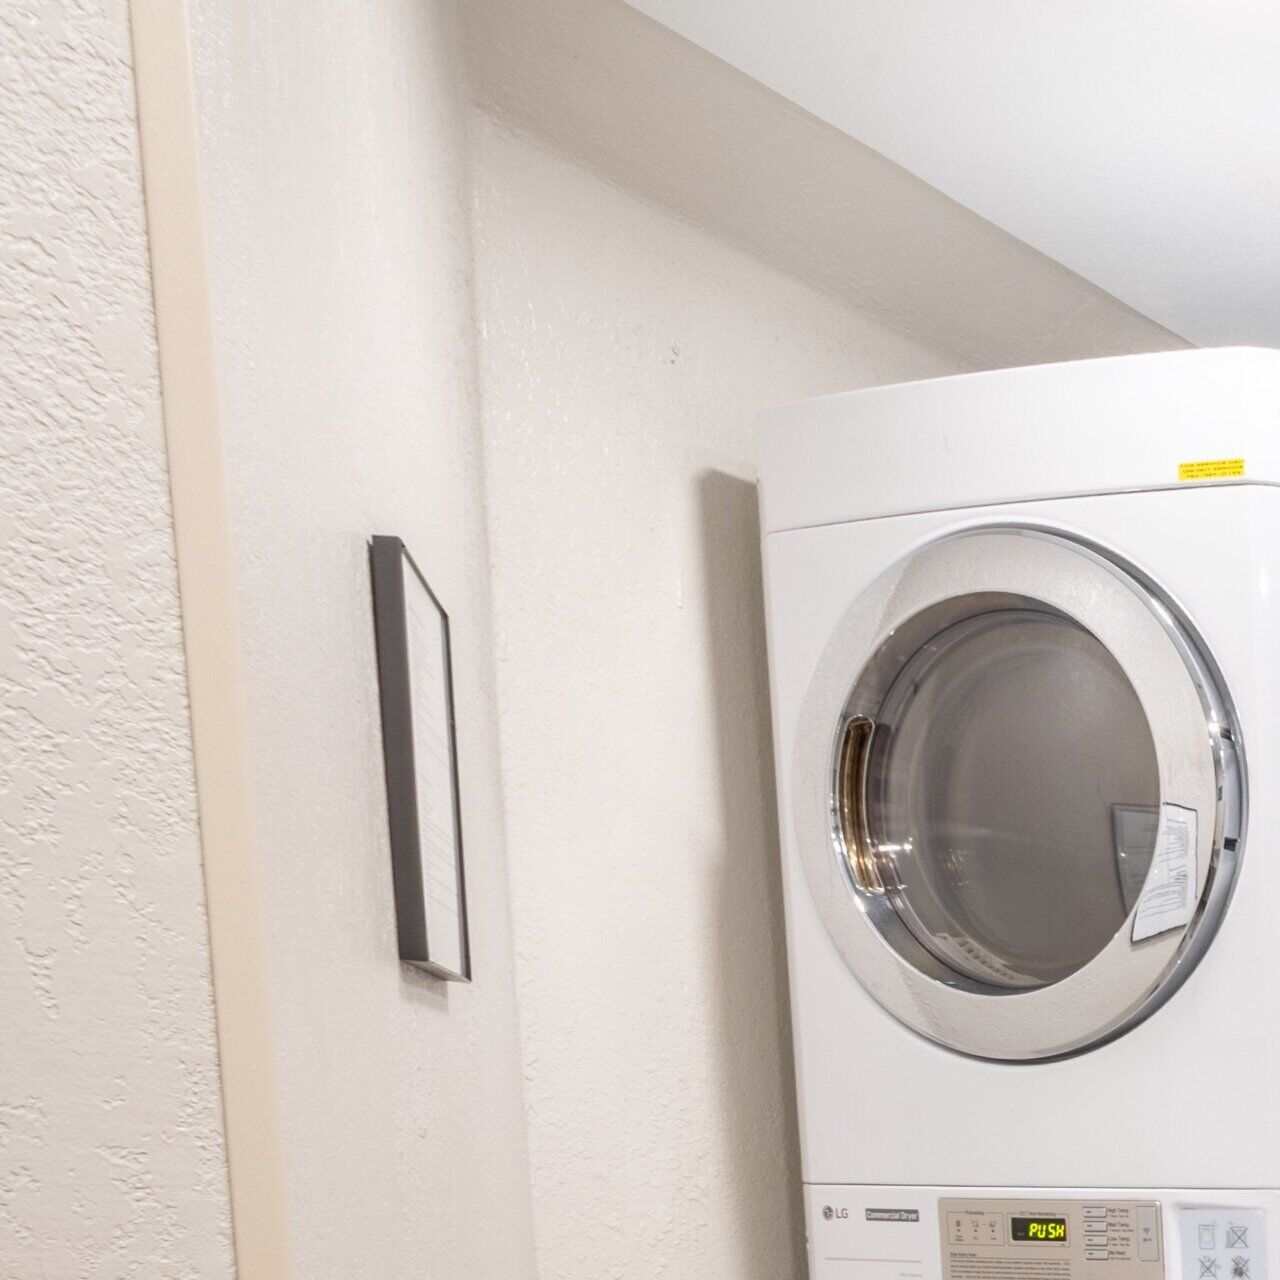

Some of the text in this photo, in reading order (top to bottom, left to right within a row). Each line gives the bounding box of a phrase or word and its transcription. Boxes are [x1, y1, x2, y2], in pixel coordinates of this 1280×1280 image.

[836, 1208, 849, 1219] LG
[867, 1210, 900, 1219] Commercial
[1029, 1223, 1065, 1238] PUSH
